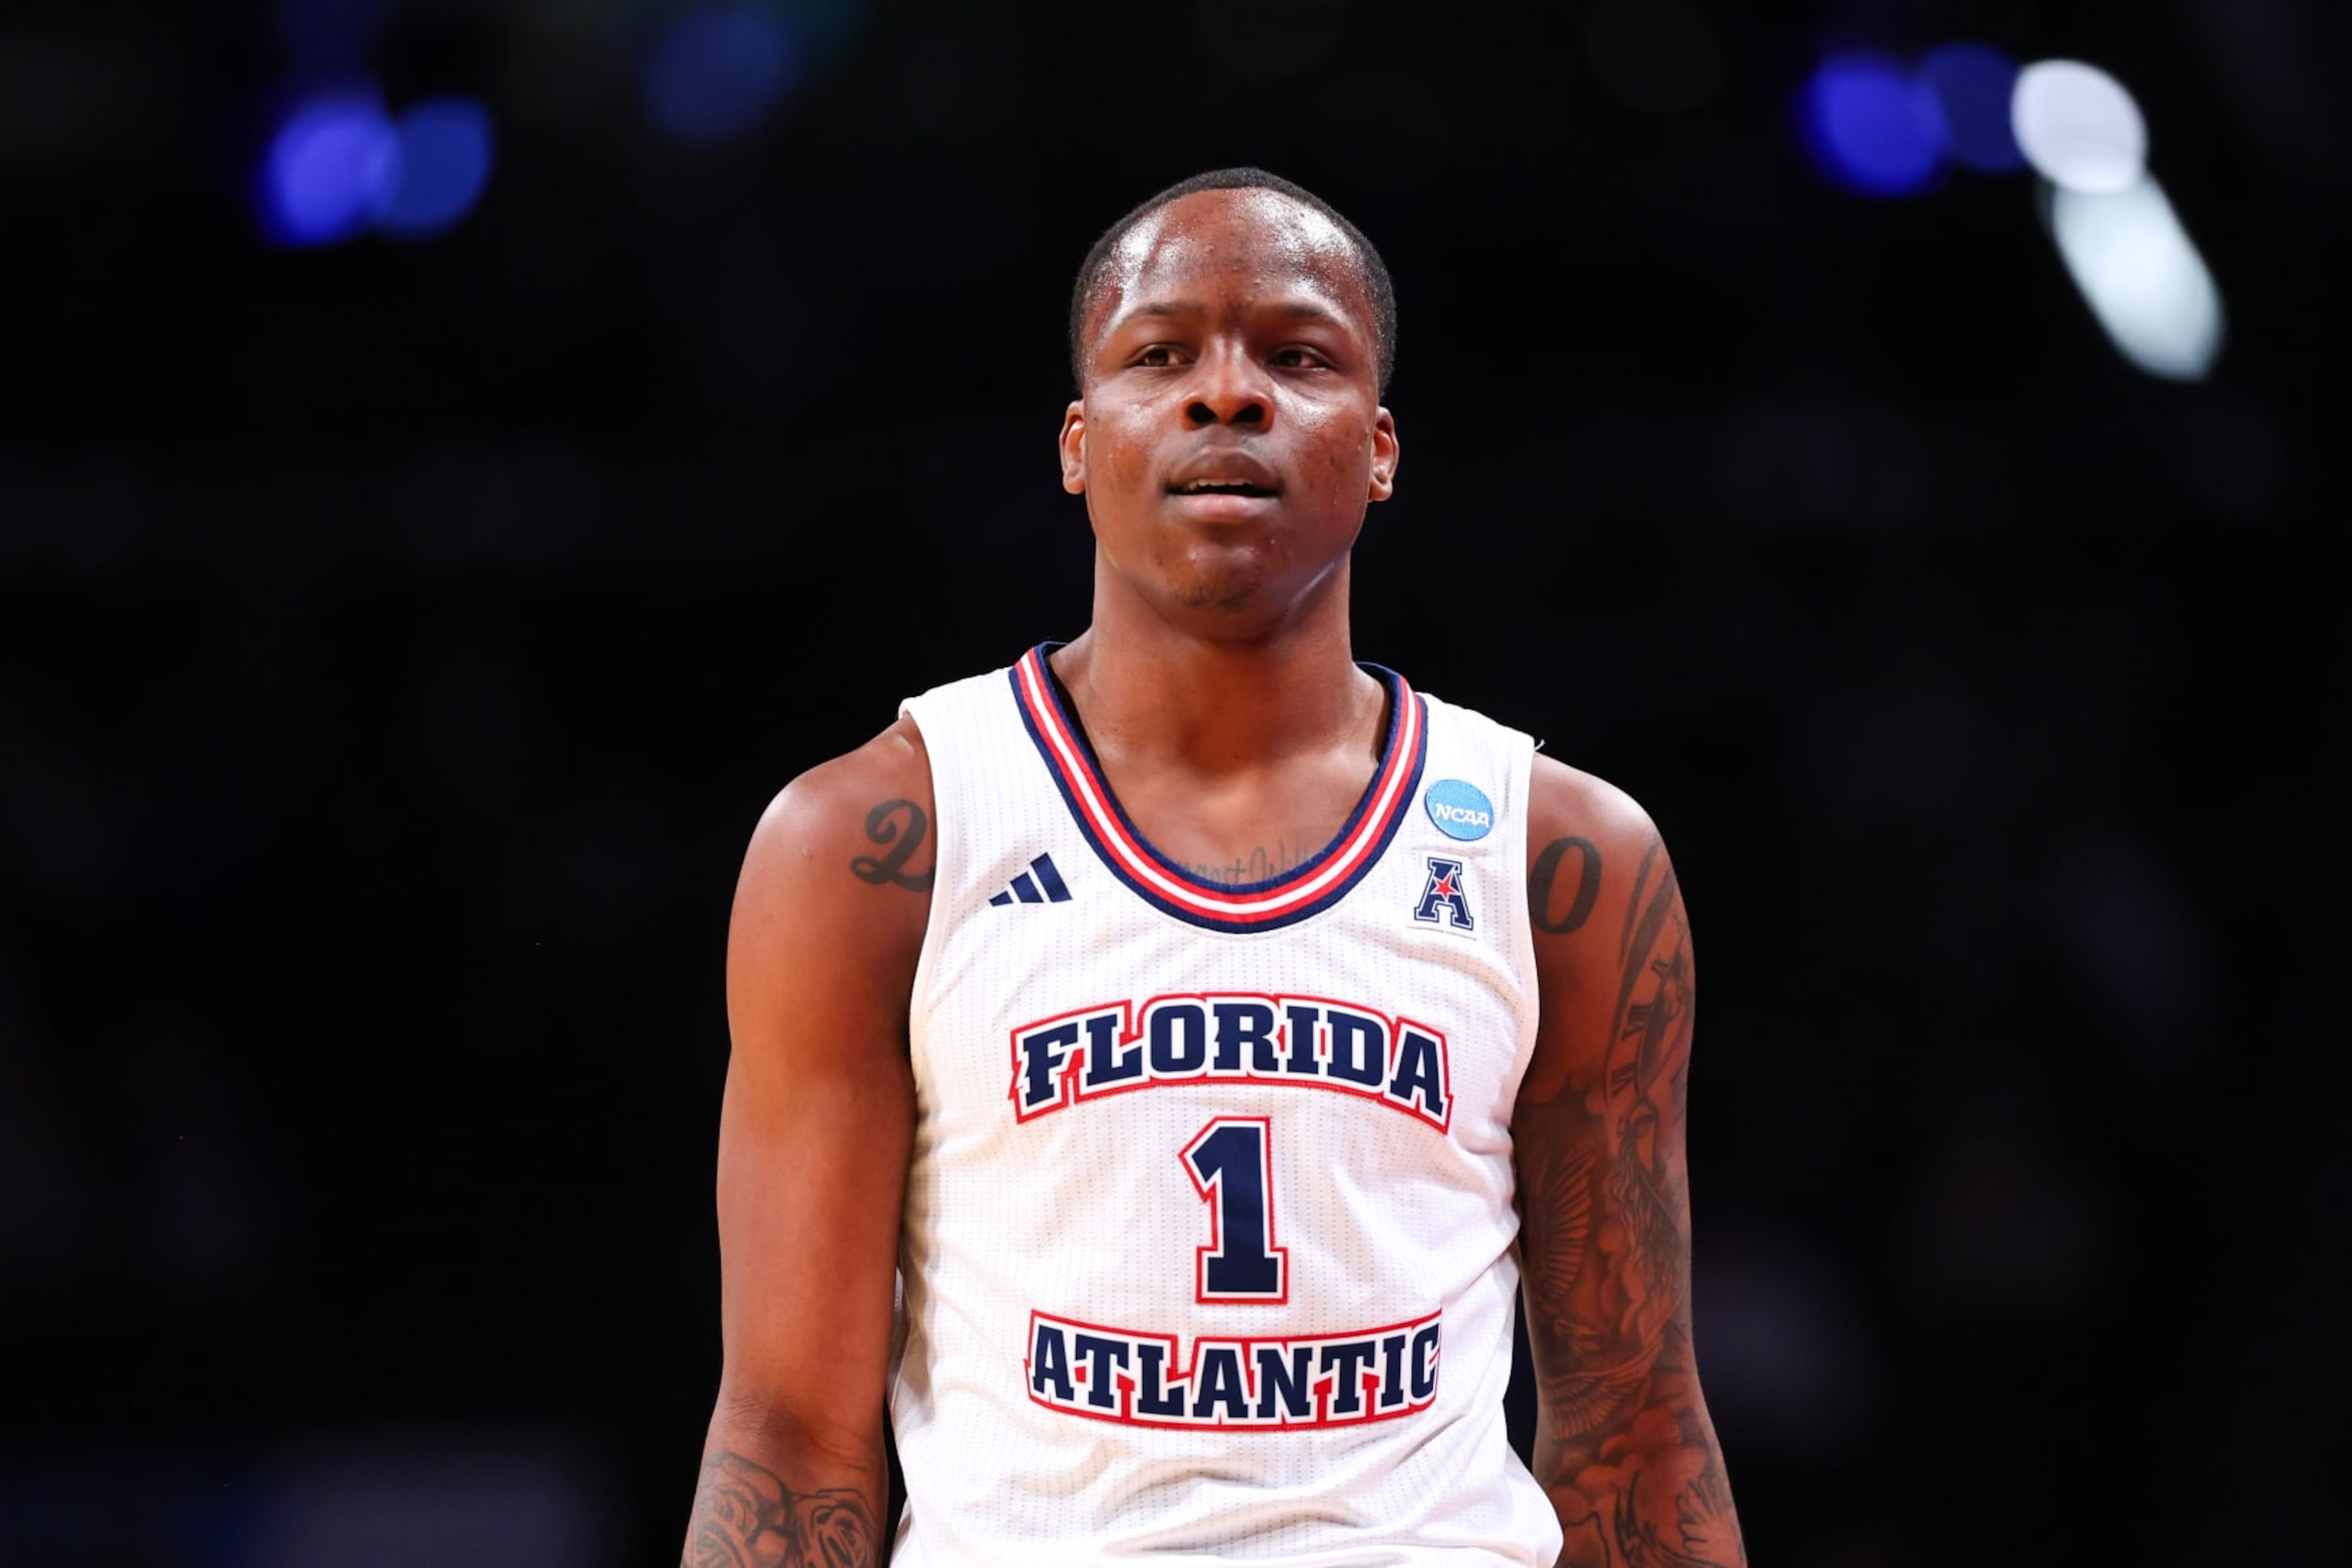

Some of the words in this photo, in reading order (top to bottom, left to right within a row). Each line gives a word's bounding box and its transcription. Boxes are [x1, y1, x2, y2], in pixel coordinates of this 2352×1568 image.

[1434, 802, 1490, 827] NCAA
[1414, 856, 1474, 931] A
[1013, 997, 1449, 1127] FLORIDA
[1185, 1121, 1283, 1298] 1
[1028, 1316, 1441, 1425] ATLANTIC
